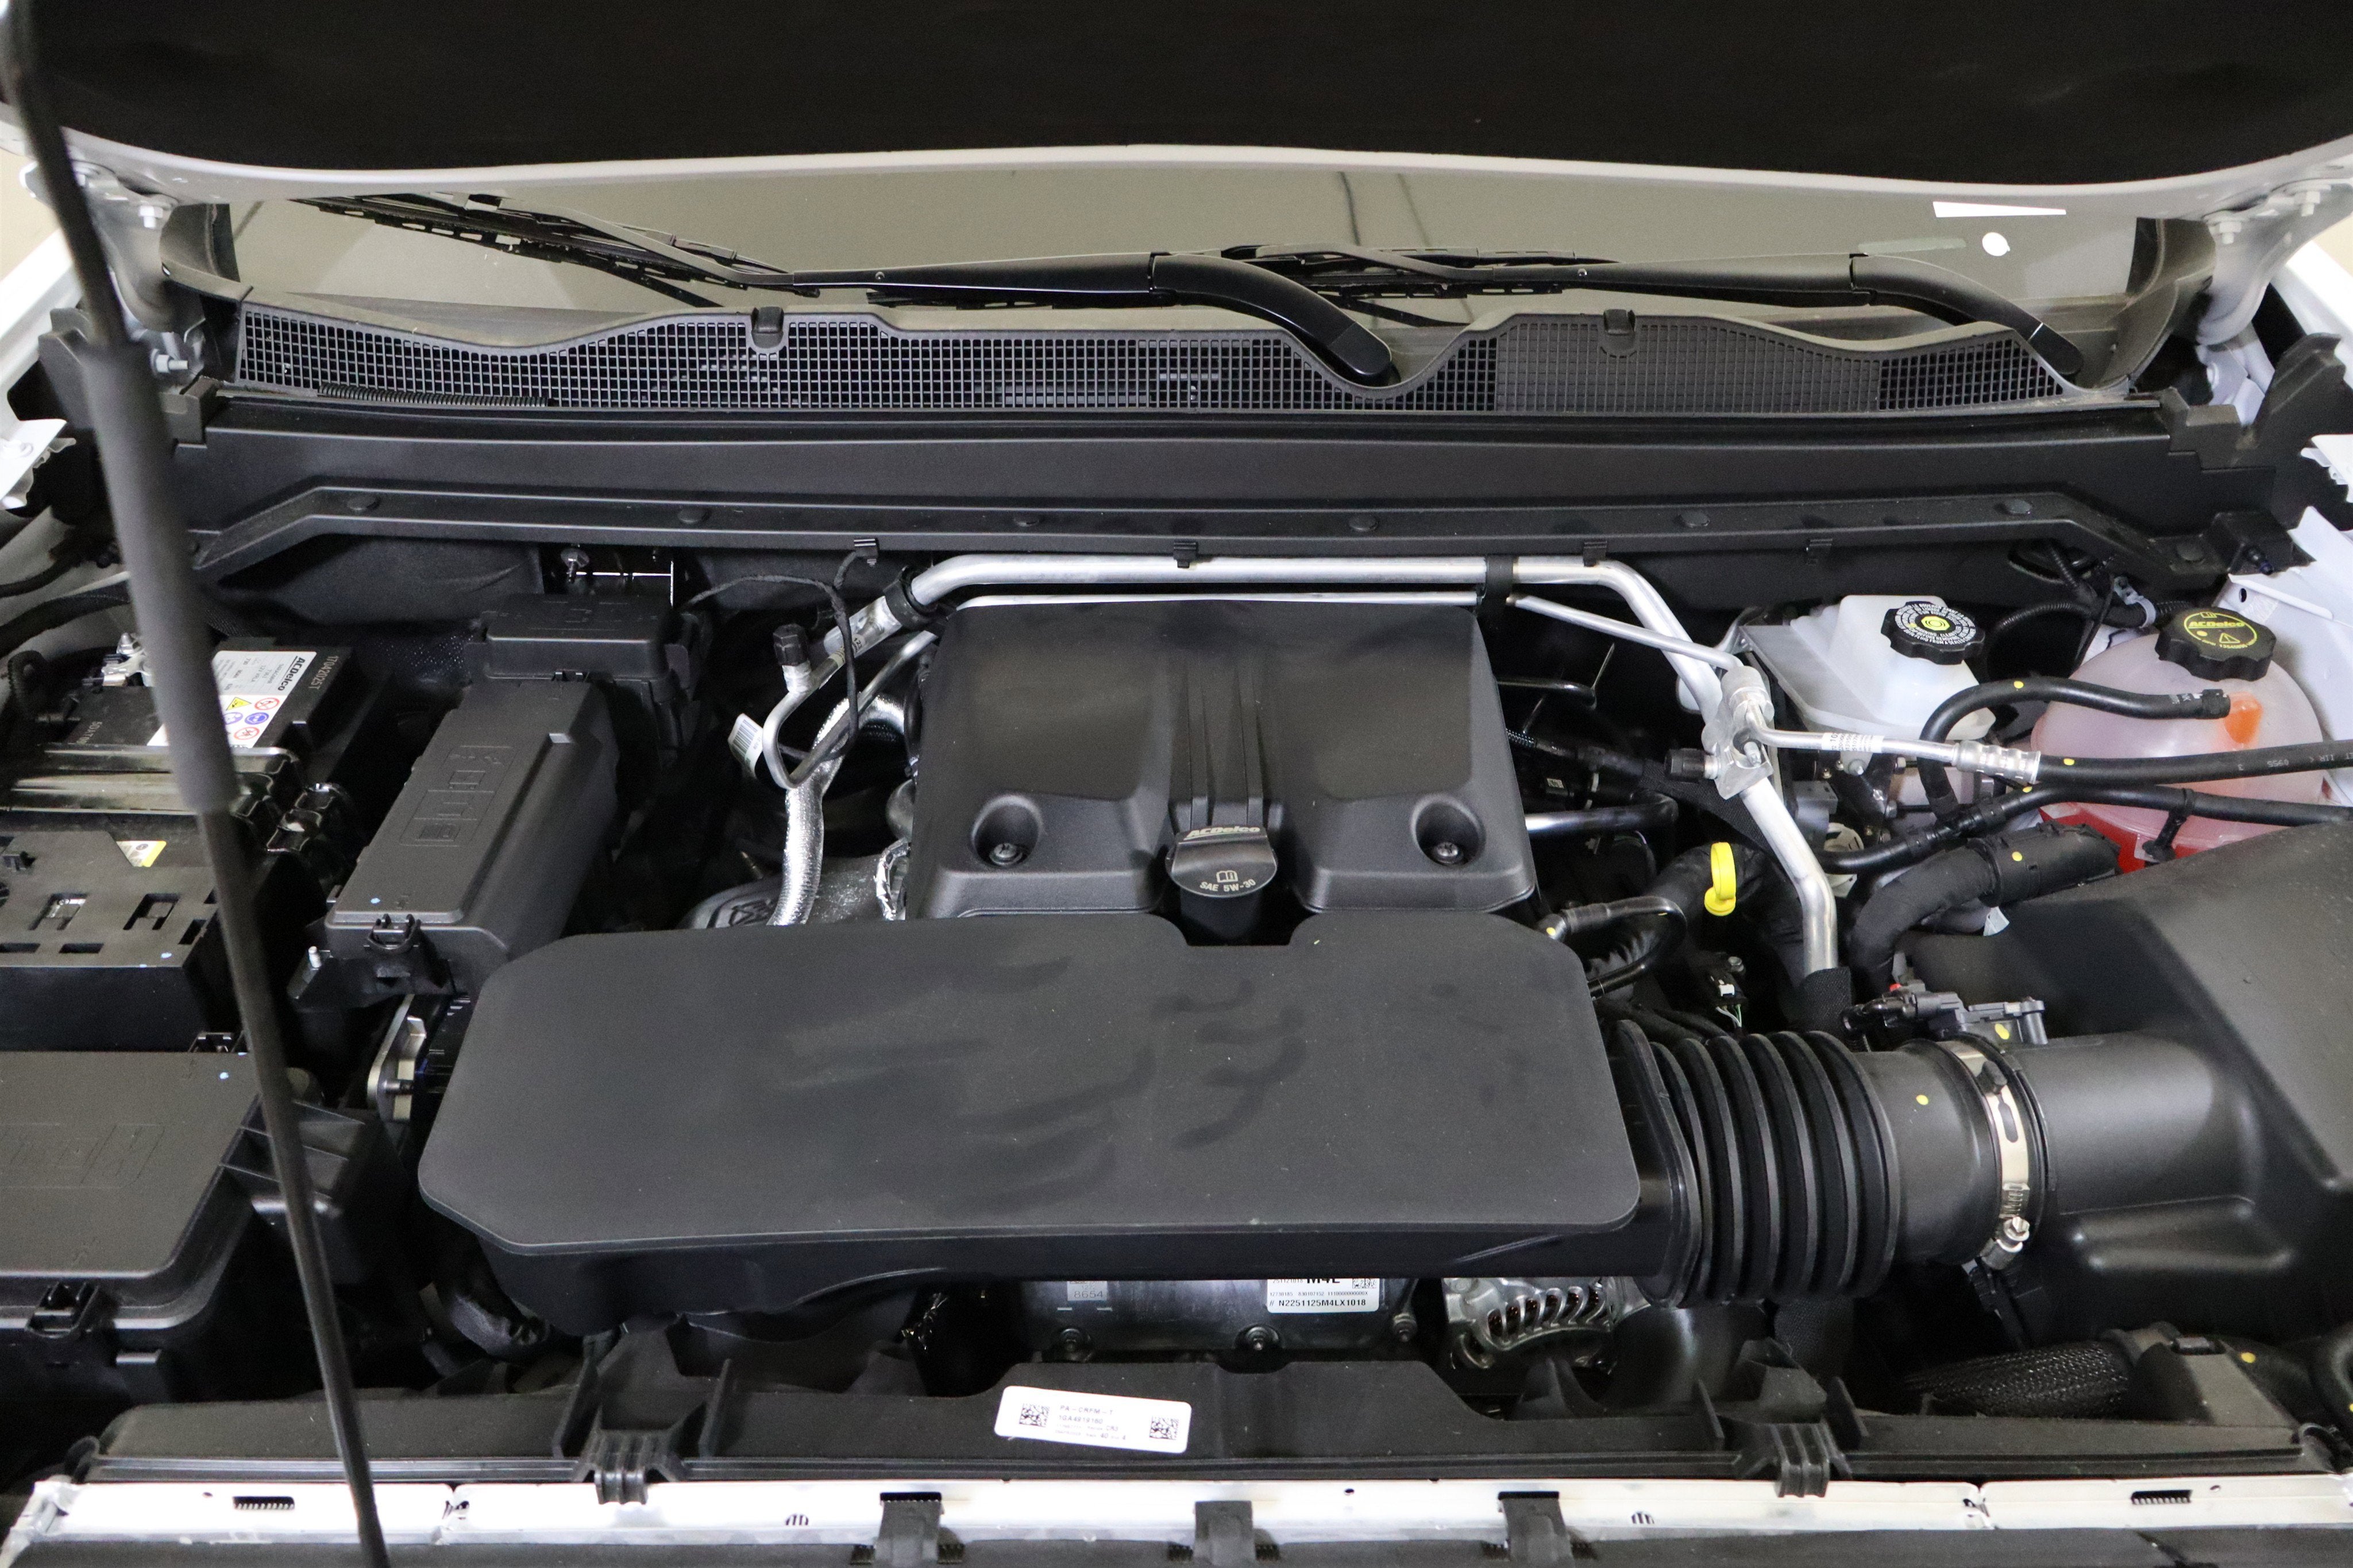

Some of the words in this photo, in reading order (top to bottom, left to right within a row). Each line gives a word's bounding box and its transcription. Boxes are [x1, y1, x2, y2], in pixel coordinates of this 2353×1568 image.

[277, 657, 306, 691] ACDelco
[308, 656, 340, 690] 17042025T
[1185, 826, 1260, 839] ACDelco
[1199, 882, 1219, 891] SAE
[1223, 879, 1256, 892] 5W-30
